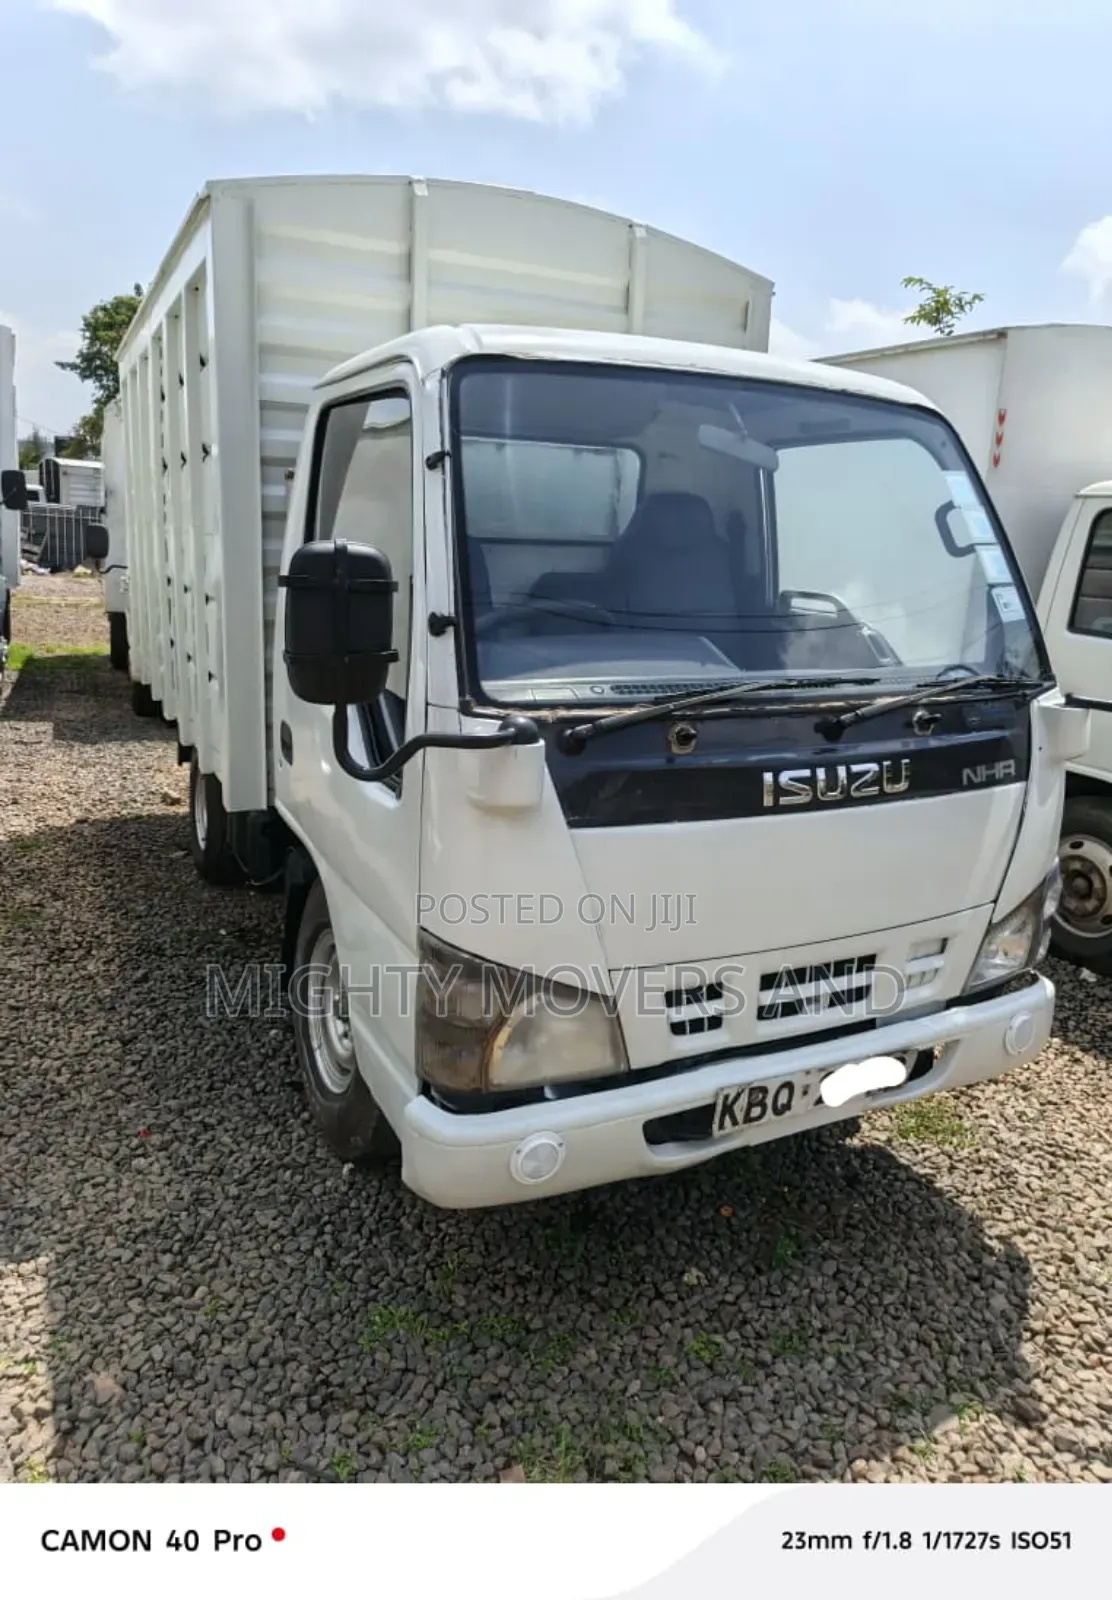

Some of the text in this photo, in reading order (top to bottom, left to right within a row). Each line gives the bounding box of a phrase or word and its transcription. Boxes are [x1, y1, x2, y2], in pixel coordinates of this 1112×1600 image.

[762, 759, 911, 807] ISUZU
[961, 759, 1016, 786] NHR
[718, 1081, 795, 1130] KBQ
